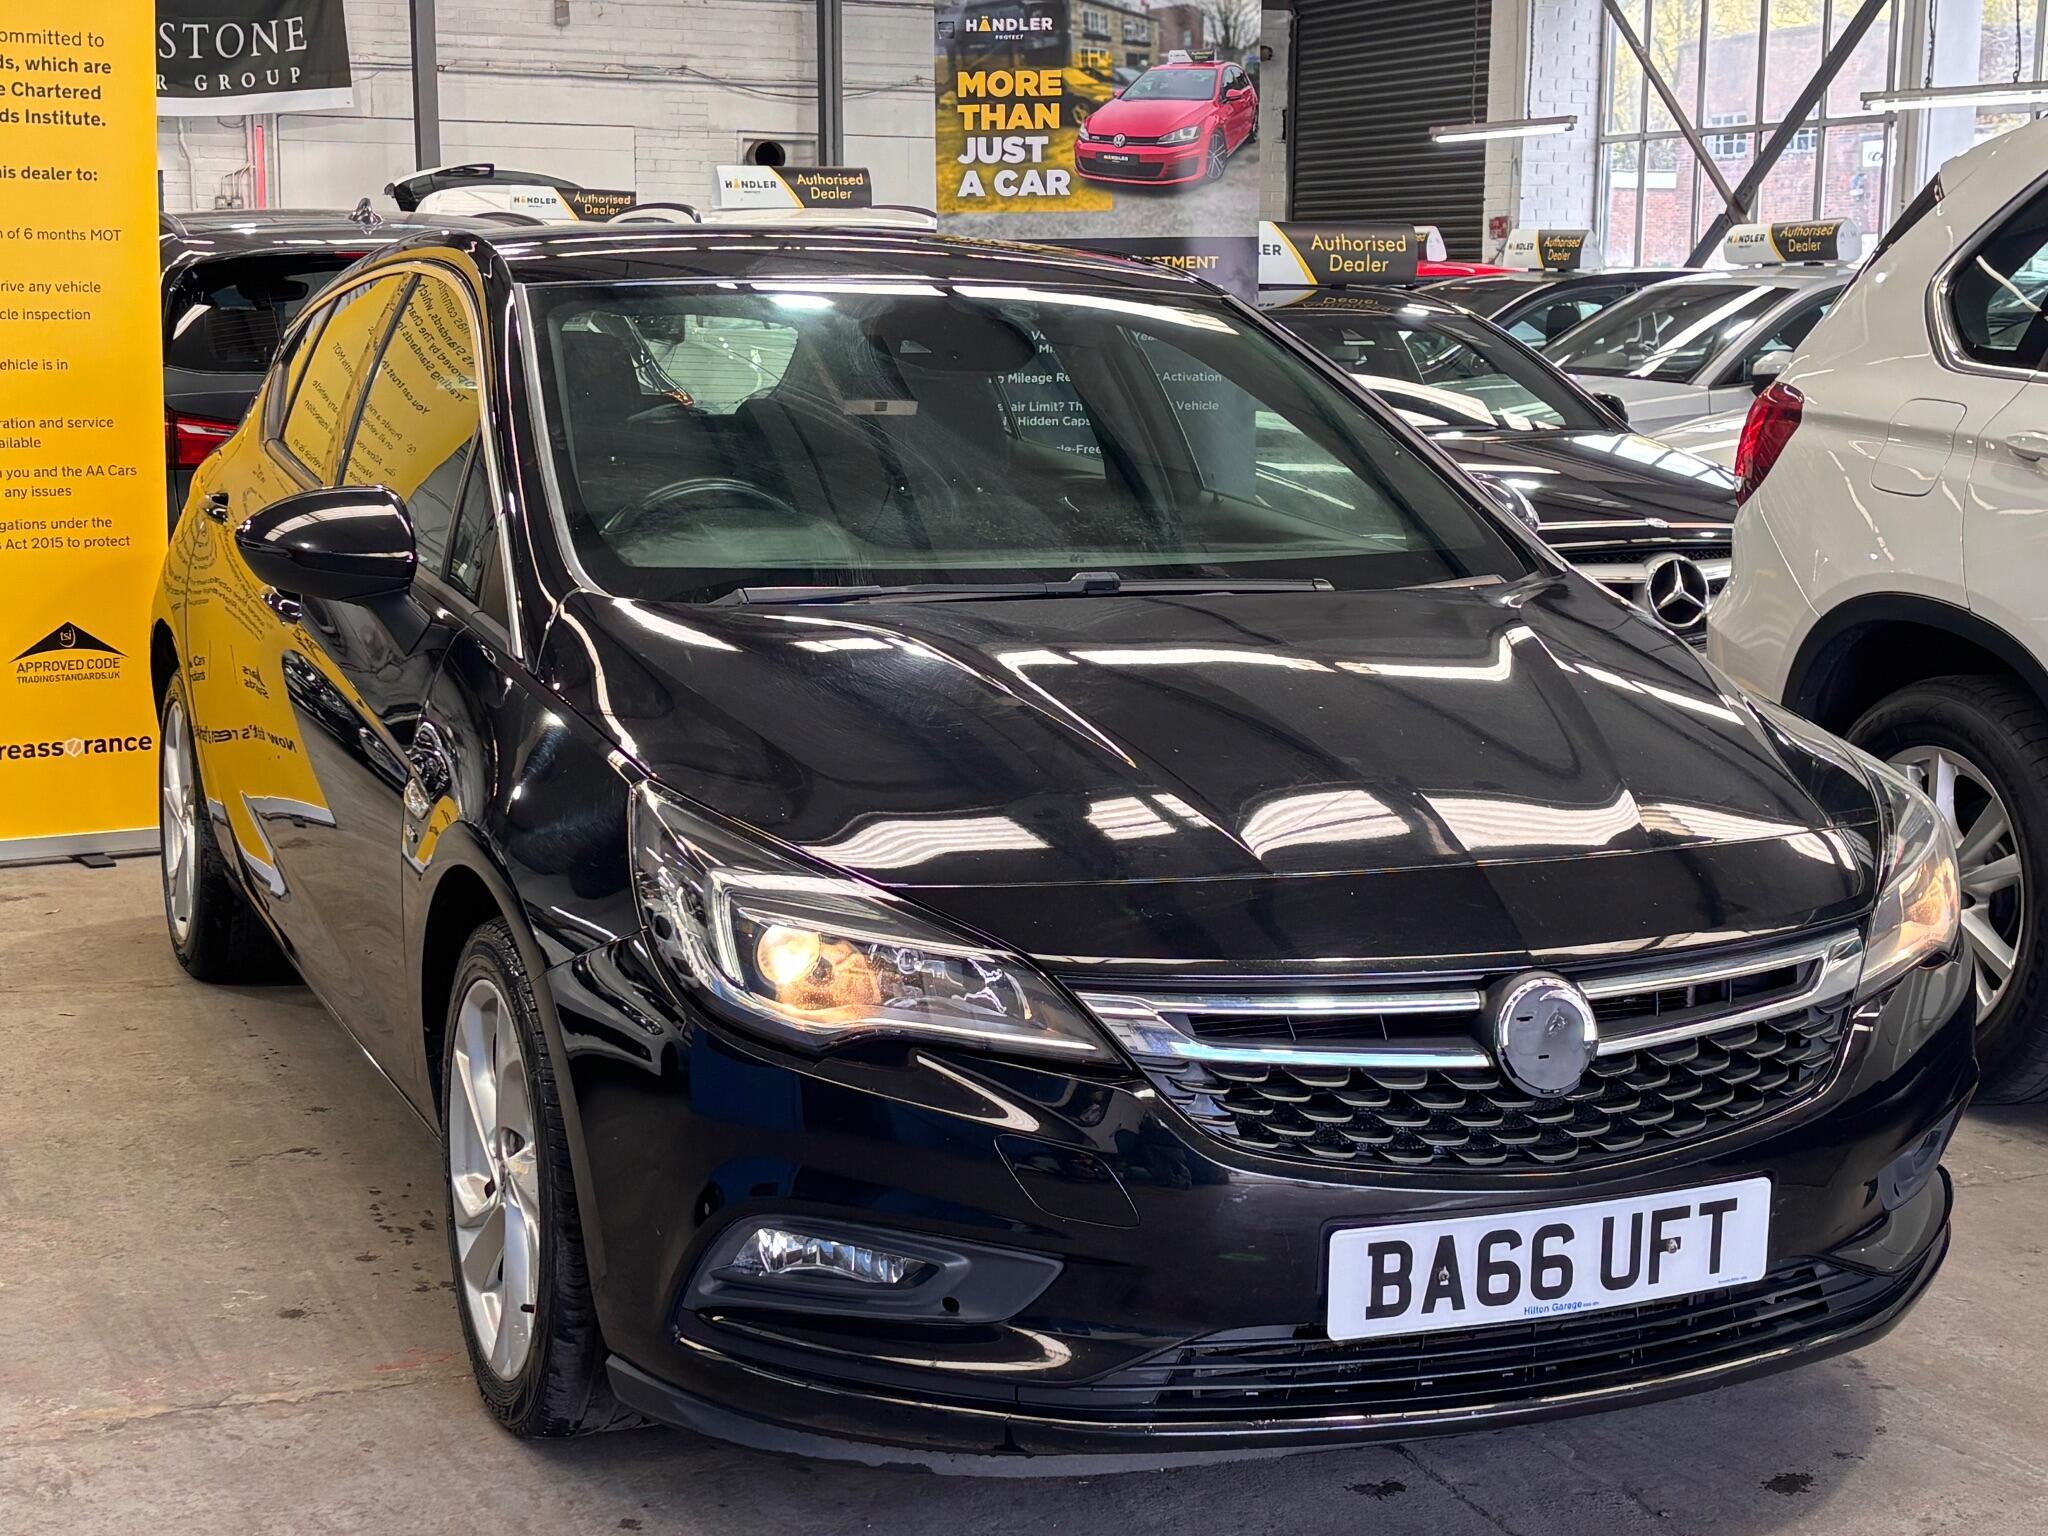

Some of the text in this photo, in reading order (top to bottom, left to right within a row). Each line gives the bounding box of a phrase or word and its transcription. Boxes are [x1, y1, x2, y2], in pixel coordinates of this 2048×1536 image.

[88, 31, 105, 48] to
[158, 16, 307, 59] STONE
[25, 56, 78, 73] which
[84, 62, 111, 74] are
[194, 67, 301, 91] GROUP
[957, 69, 1062, 98] MORE
[11, 82, 101, 100] Chartered
[25, 109, 106, 127] Institute.
[957, 102, 1060, 131] THAN
[957, 136, 1048, 164] JUST
[0, 165, 98, 181] is dealer to:
[797, 173, 864, 187] Authorised
[957, 169, 1071, 197] A CAR
[574, 190, 631, 205] Authorised
[810, 186, 853, 200] Dealer
[584, 204, 620, 215] Dealer
[8, 228, 20, 240] of
[24, 228, 33, 240] 6
[37, 229, 86, 241] months
[90, 229, 122, 241] MOT
[1311, 233, 1407, 253] Authorised
[1788, 239, 1822, 253] Dealer
[1143, 255, 1219, 269] TMENT
[1329, 254, 1389, 272] Dealer
[28, 282, 52, 295] any
[55, 281, 102, 293] vehicle
[22, 309, 91, 322] inspection
[42, 359, 53, 371] is
[56, 359, 69, 371] in
[1007, 372, 1053, 385] Mileage
[1163, 372, 1222, 382] Activation
[1029, 402, 1064, 412] Limit?
[1176, 401, 1220, 411] Vehicle
[39, 417, 64, 429] and
[67, 416, 114, 428] service
[1018, 417, 1060, 427] Hidden
[5, 468, 30, 480] you
[33, 466, 58, 478] and
[62, 466, 83, 478] the
[86, 464, 105, 477] AA
[107, 464, 138, 477] Cars
[4, 486, 72, 500] any issues
[51, 518, 88, 530] under
[92, 517, 113, 529] the
[5, 535, 131, 550] Act 2015 to protect
[16, 657, 121, 674] APPROVED CODE
[1365, 1197, 1738, 1320] BA66 UFT
[1524, 1301, 1583, 1316] Hilton Garage
